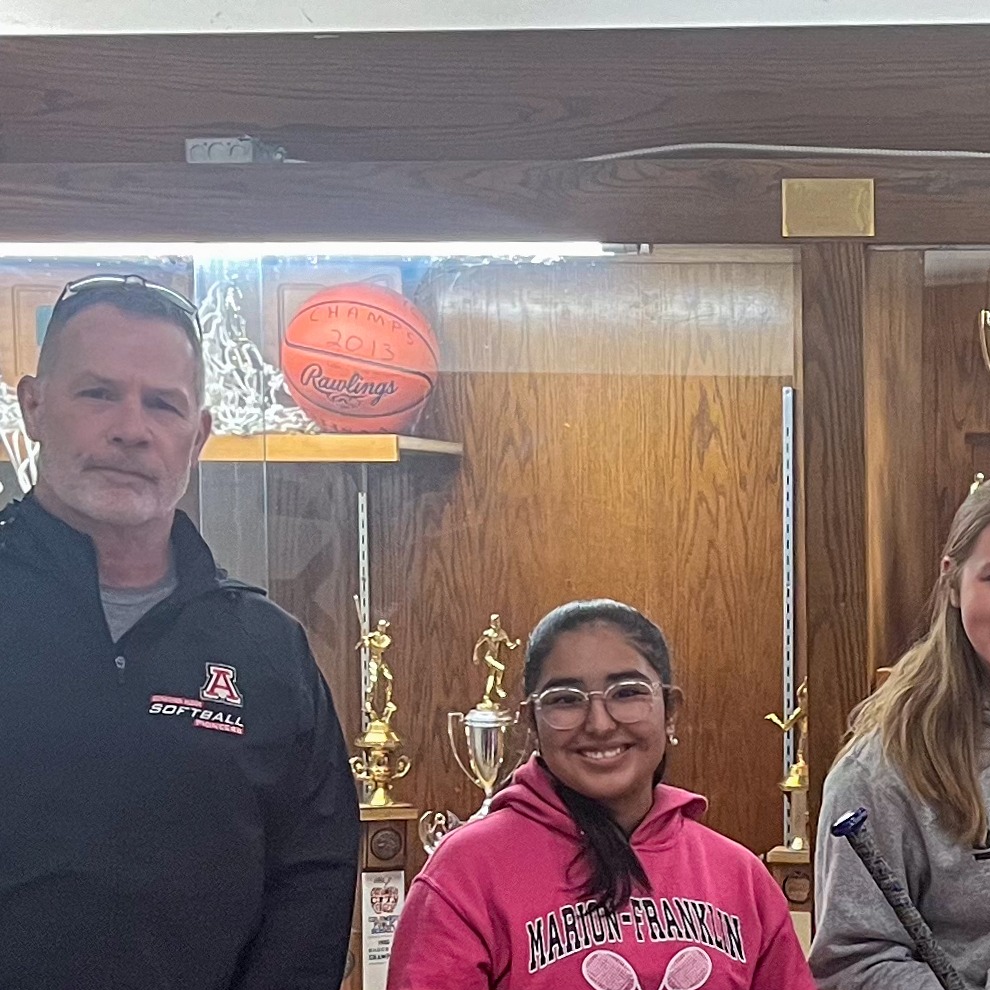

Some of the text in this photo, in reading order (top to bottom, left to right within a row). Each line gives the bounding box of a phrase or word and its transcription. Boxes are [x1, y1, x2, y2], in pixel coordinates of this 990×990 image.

[309, 305, 415, 346] CHAMPS
[326, 328, 395, 361] 2013
[300, 363, 399, 406] Rawlings
[149, 703, 245, 728] SOFTBALL
[526, 896, 747, 974] MARION-FRANKLIN
